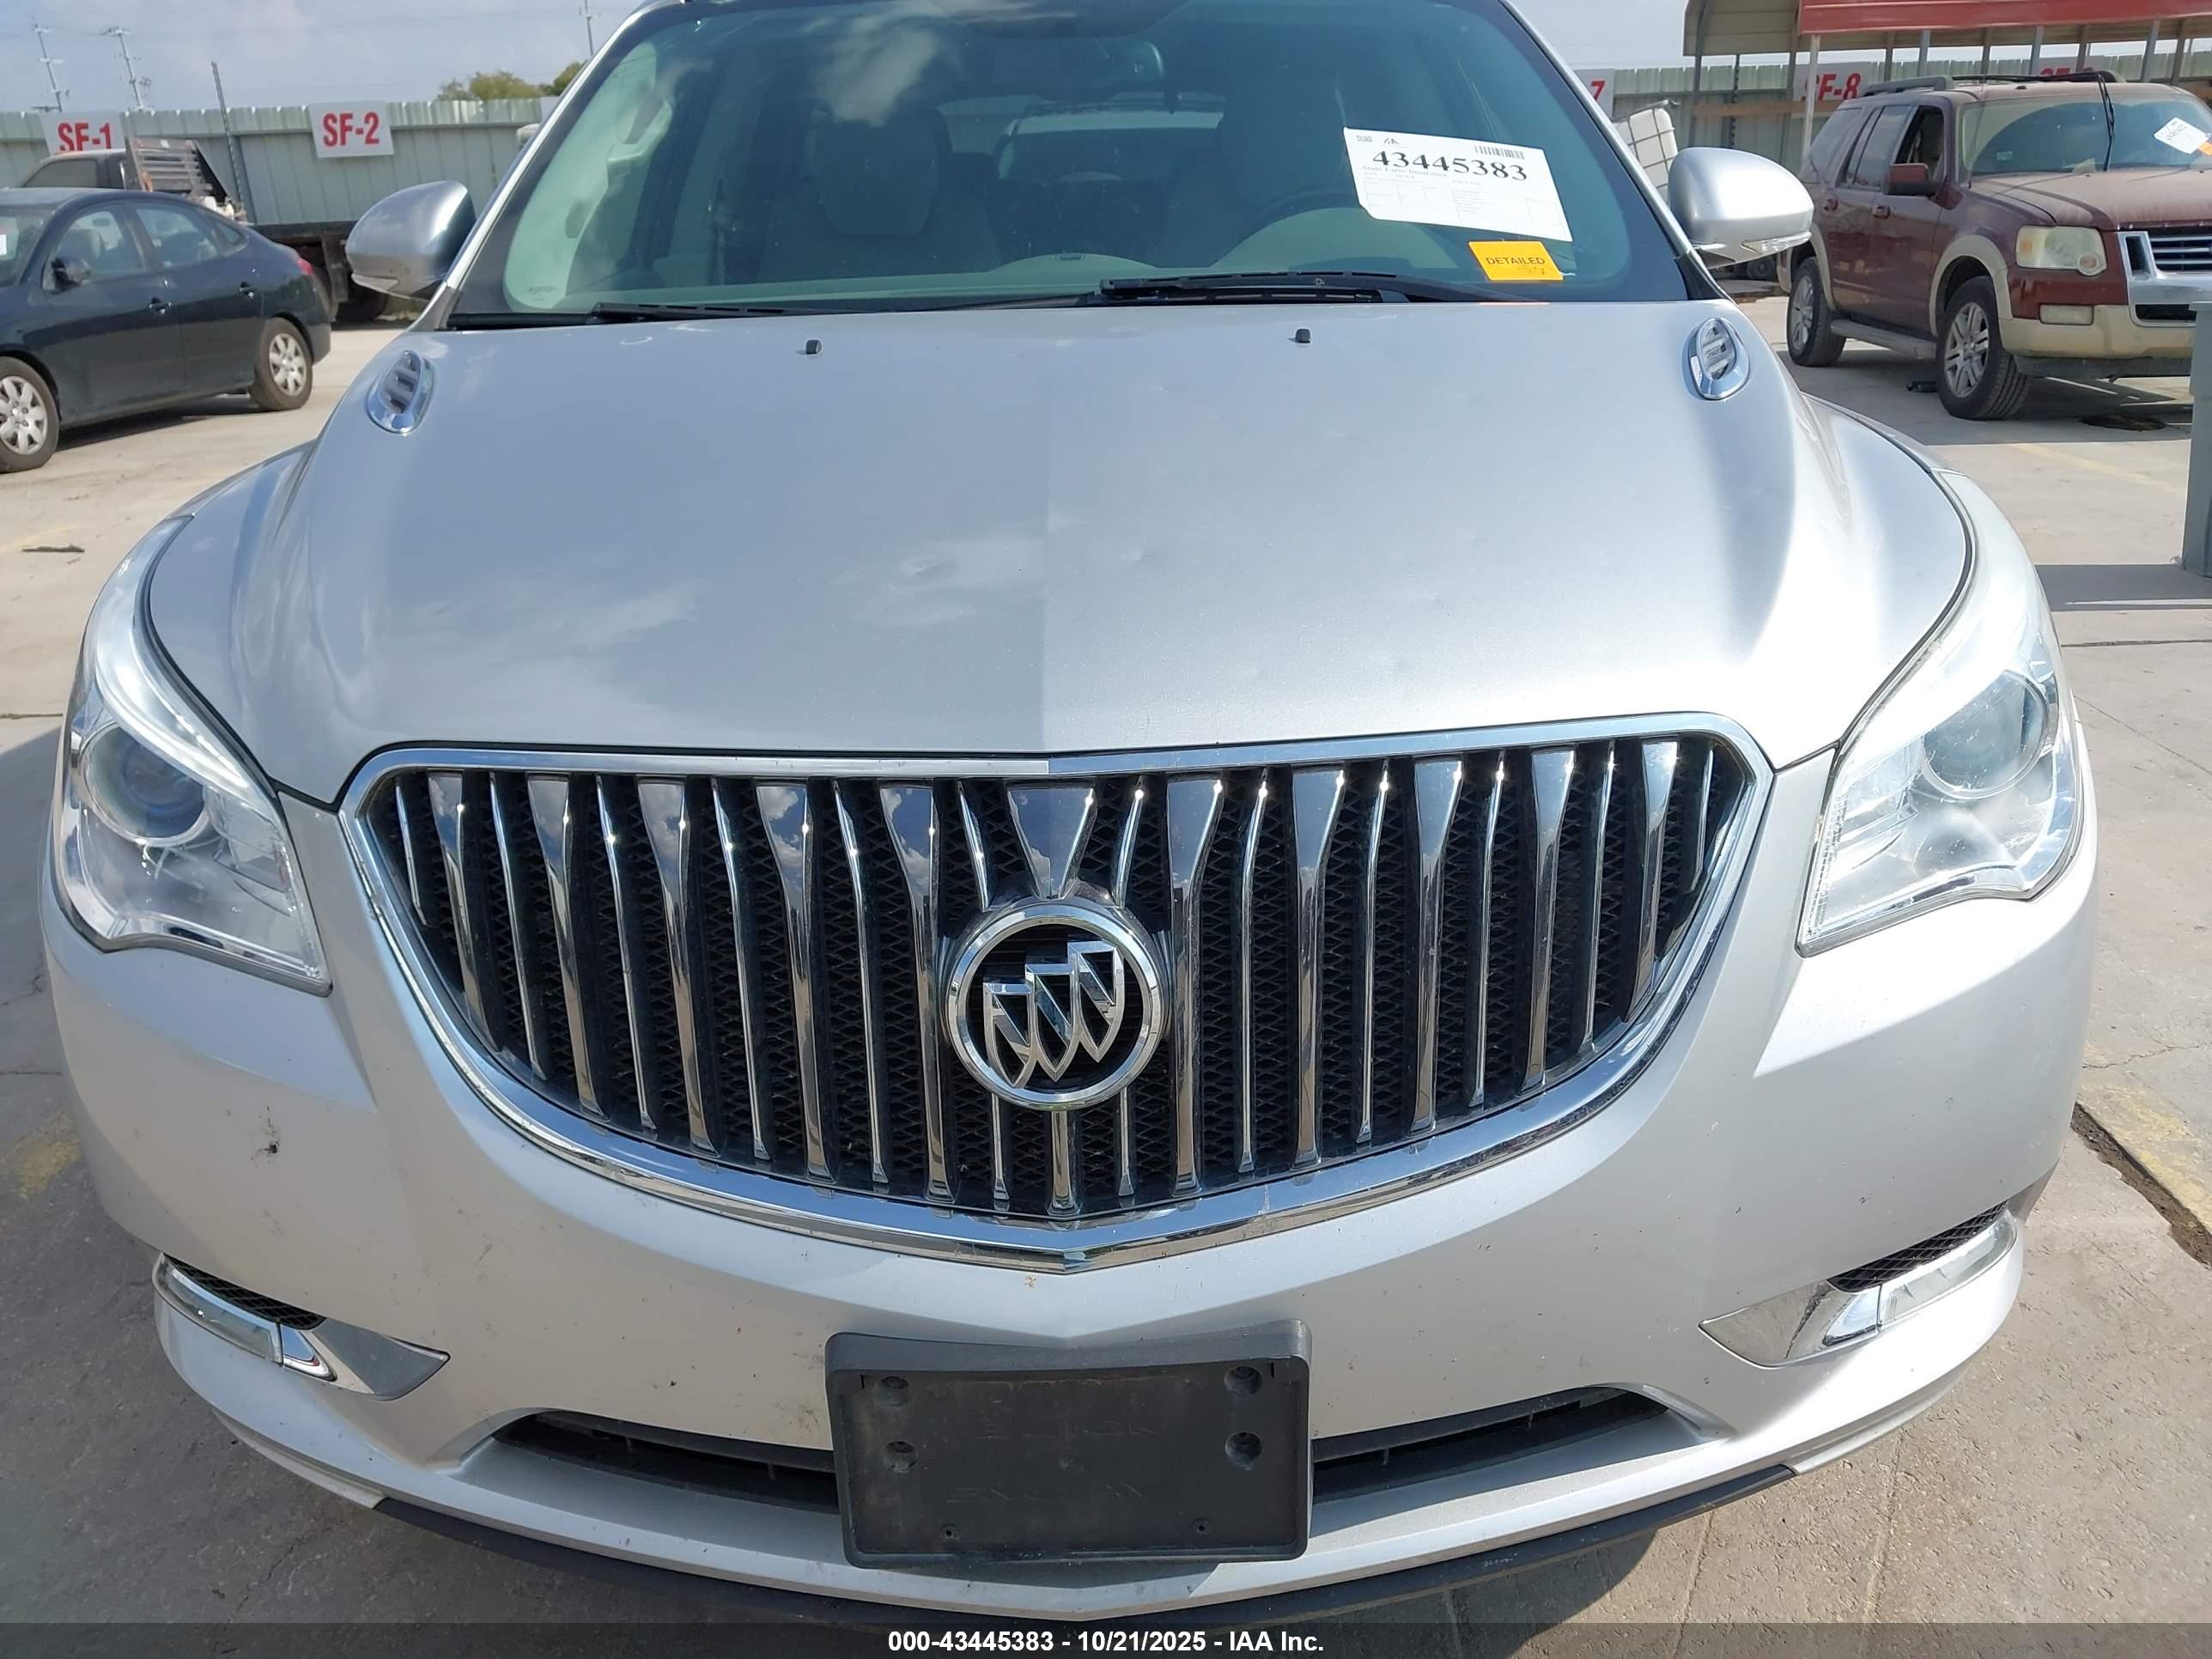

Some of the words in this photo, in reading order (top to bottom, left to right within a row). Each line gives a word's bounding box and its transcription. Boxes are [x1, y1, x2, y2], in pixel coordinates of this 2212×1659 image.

[57, 122, 112, 152] SF-1
[323, 112, 380, 147] SF-2
[1372, 150, 1527, 181] 43445383
[1486, 256, 1546, 266] DETAILED
